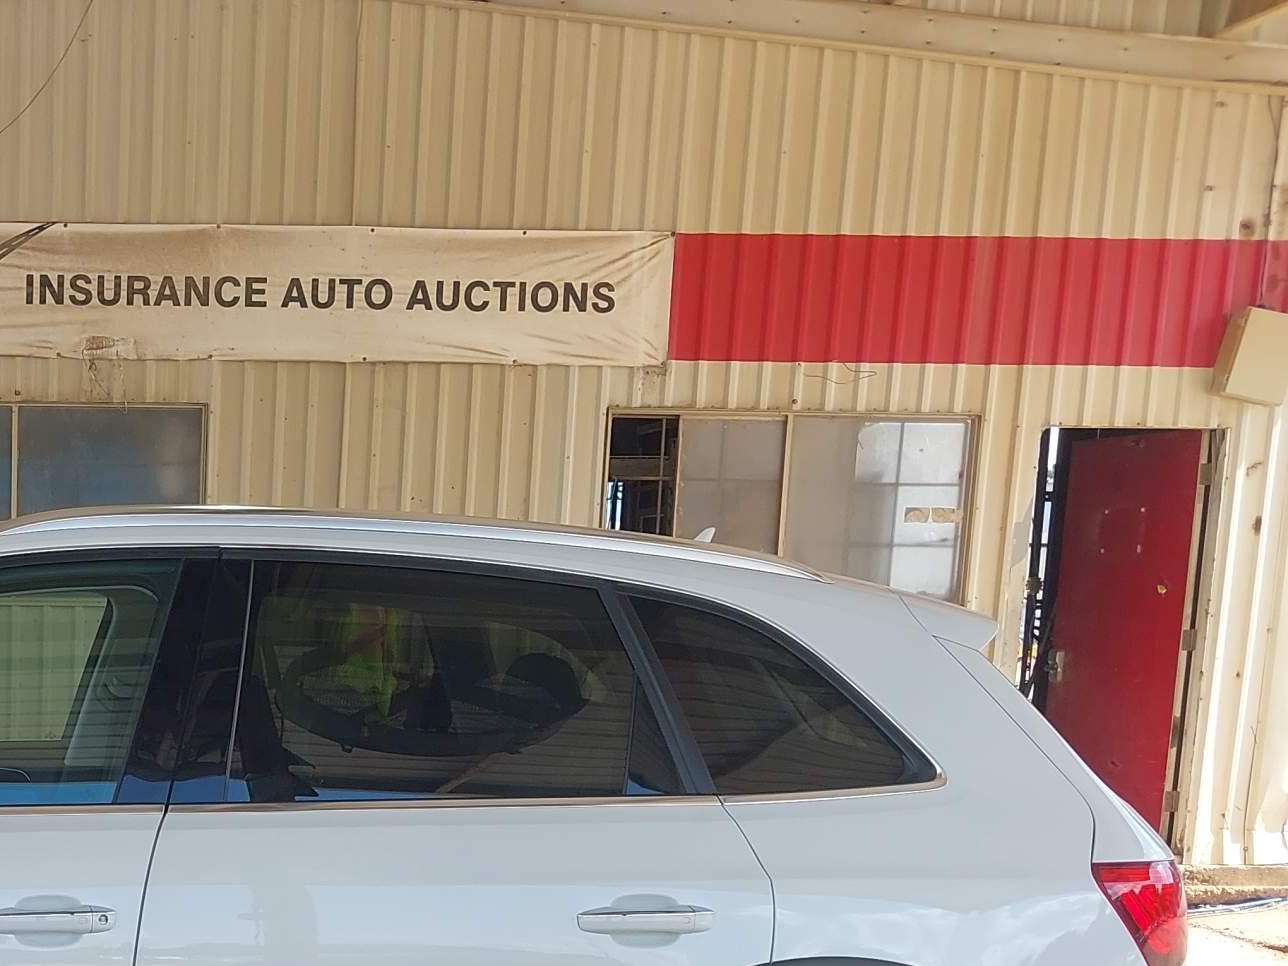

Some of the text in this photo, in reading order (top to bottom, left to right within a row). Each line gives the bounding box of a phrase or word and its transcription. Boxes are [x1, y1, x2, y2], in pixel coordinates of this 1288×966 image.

[25, 273, 615, 313] INSURANCE AUTO AUCTIONS
